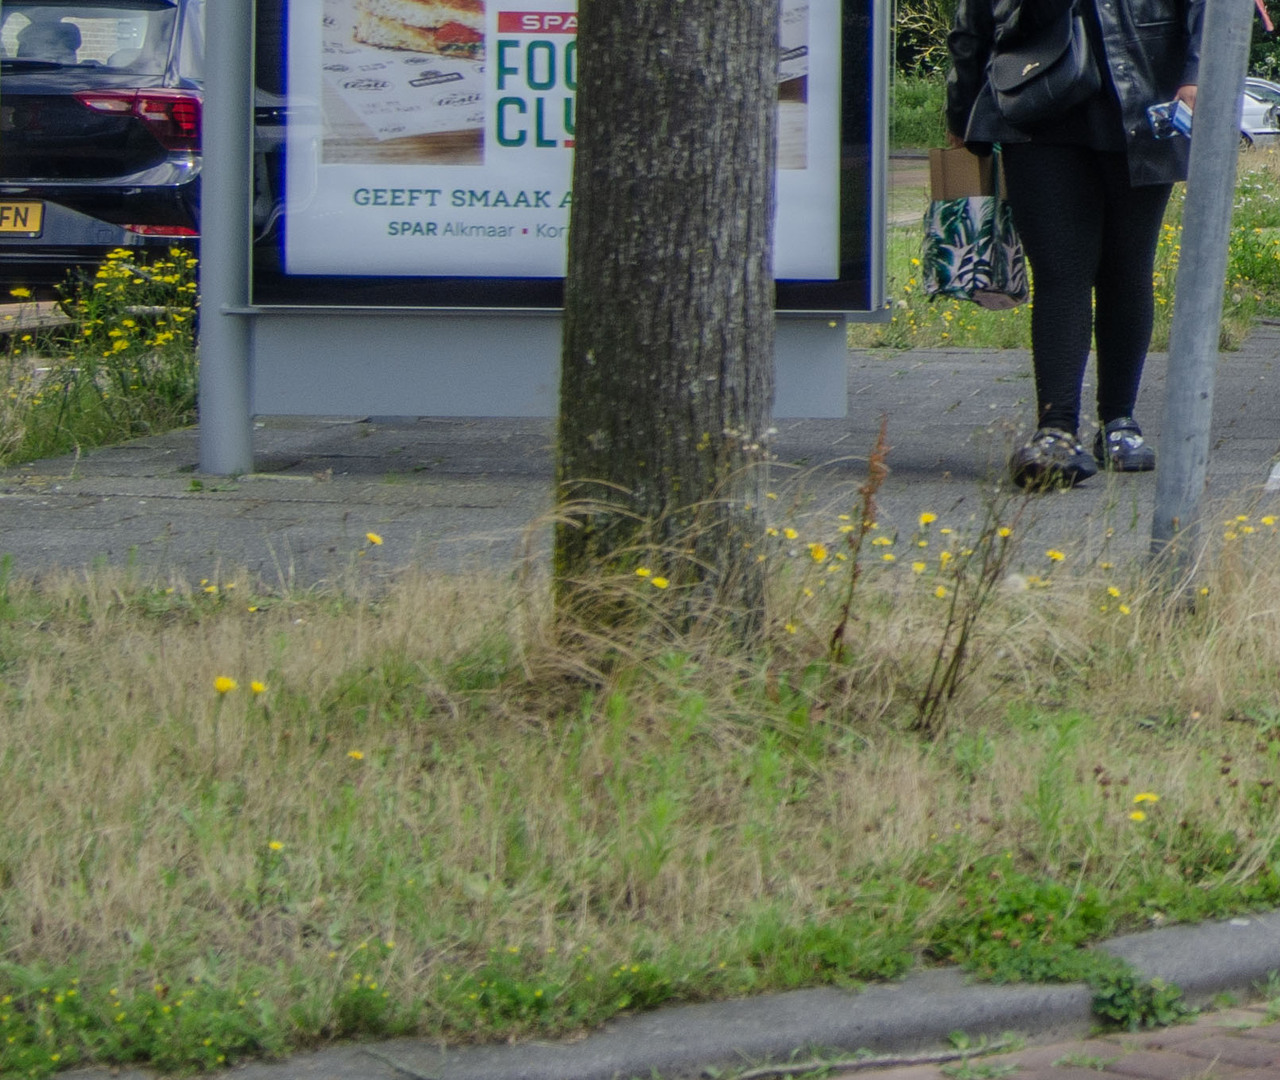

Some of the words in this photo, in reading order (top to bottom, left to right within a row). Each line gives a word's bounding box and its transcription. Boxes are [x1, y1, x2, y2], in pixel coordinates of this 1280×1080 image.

[354, 188, 442, 207] GEEFT
[451, 190, 551, 208] SMAAK
[388, 222, 437, 236] SPAR
[443, 222, 514, 238] Alkmaar
[535, 223, 568, 238] Kor
